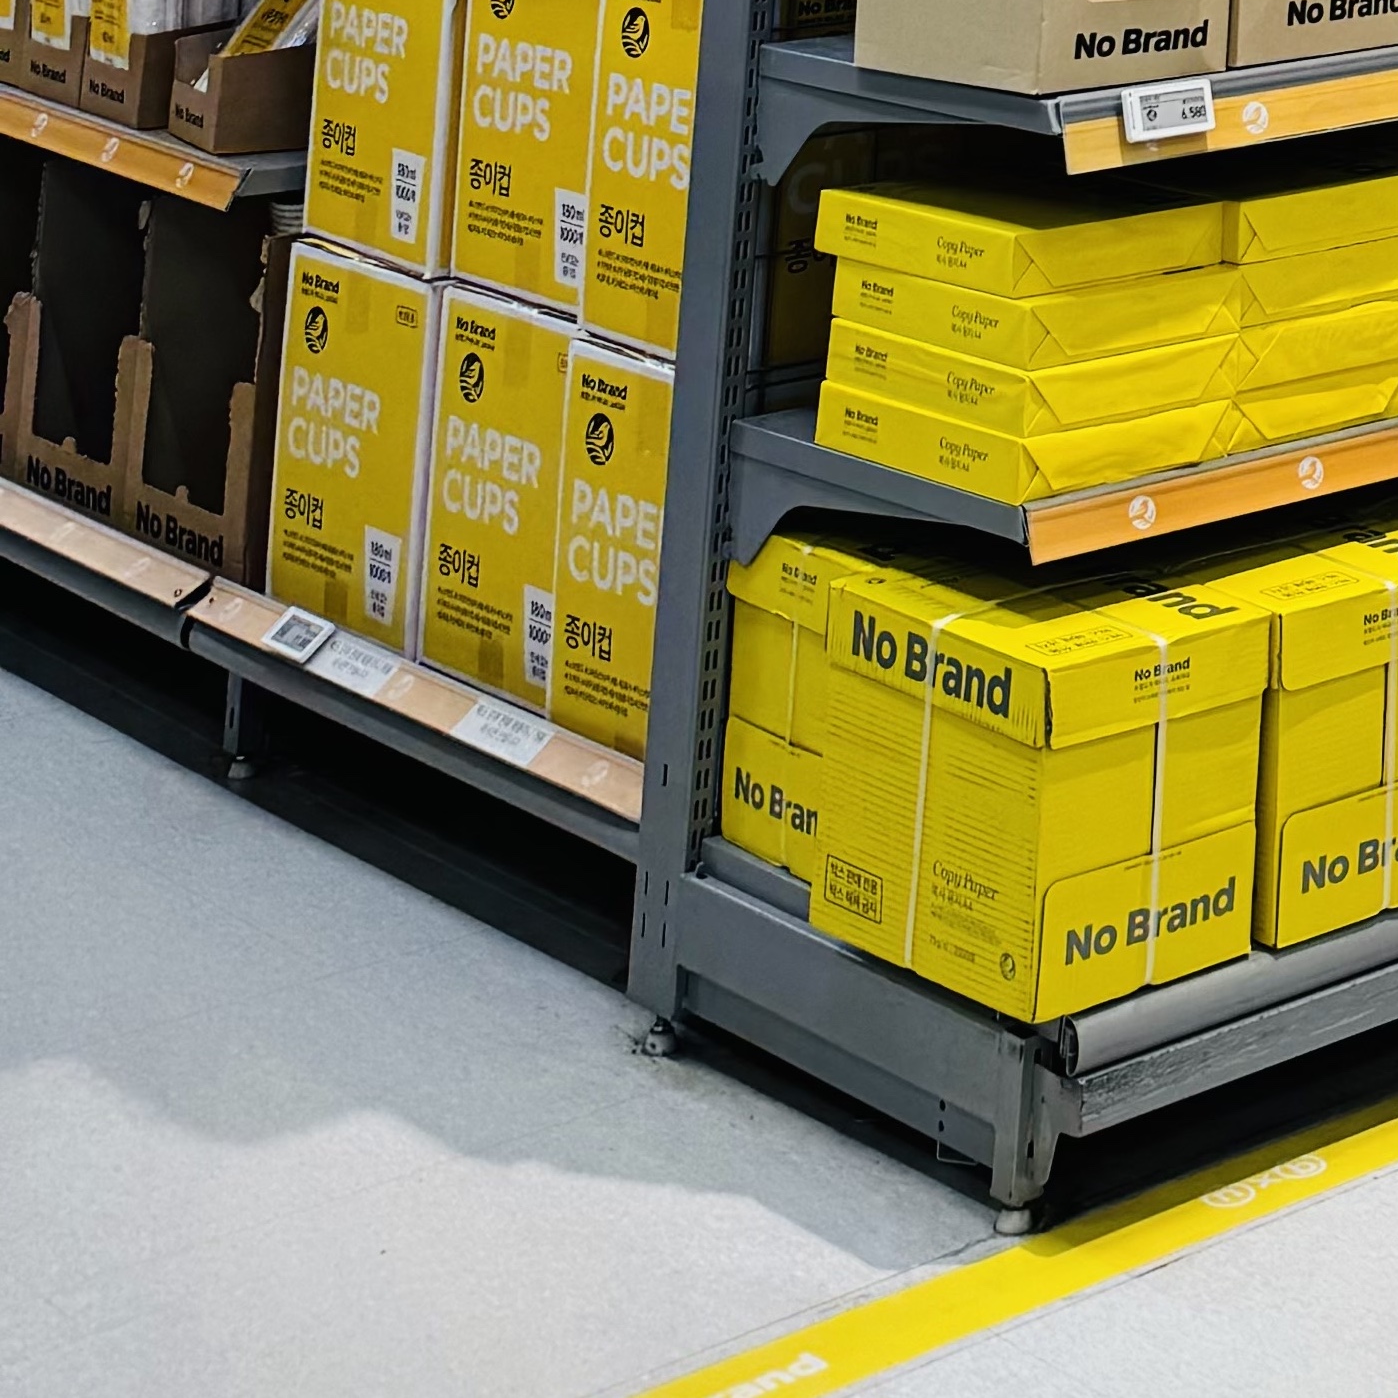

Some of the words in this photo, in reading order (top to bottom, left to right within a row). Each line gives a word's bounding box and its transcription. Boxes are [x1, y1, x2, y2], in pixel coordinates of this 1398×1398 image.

[329, 0, 409, 59] PAPER
[1074, 32, 1116, 60] No
[1121, 20, 1209, 56] Brand
[1287, 0, 1324, 26] No
[324, 49, 390, 104] CUPS
[476, 33, 573, 95] PAPER
[473, 86, 550, 142] CUPS
[607, 72, 692, 136] PAPE
[321, 118, 356, 156] 종이컵
[601, 126, 690, 190] CUPS
[469, 158, 512, 197] 종이컵
[598, 204, 645, 248] 종이컵
[936, 235, 959, 256] Copy
[960, 242, 985, 259] Paper
[951, 305, 974, 326] Copy
[975, 311, 1000, 330] Paper
[292, 366, 381, 436] PAPER
[947, 371, 969, 391] Copy
[970, 377, 995, 396] Paper
[288, 417, 361, 479] CUPS
[444, 414, 542, 488] PAPER
[442, 468, 519, 536] CUPS
[571, 479, 658, 550] PAPE
[567, 536, 657, 607] CUPS
[851, 609, 897, 670] No
[904, 626, 1013, 719] Brand
[734, 766, 765, 805] No
[769, 784, 818, 837] Bran
[1301, 852, 1350, 895] No
[1064, 922, 1117, 965] No
[1125, 876, 1237, 944] Brand
